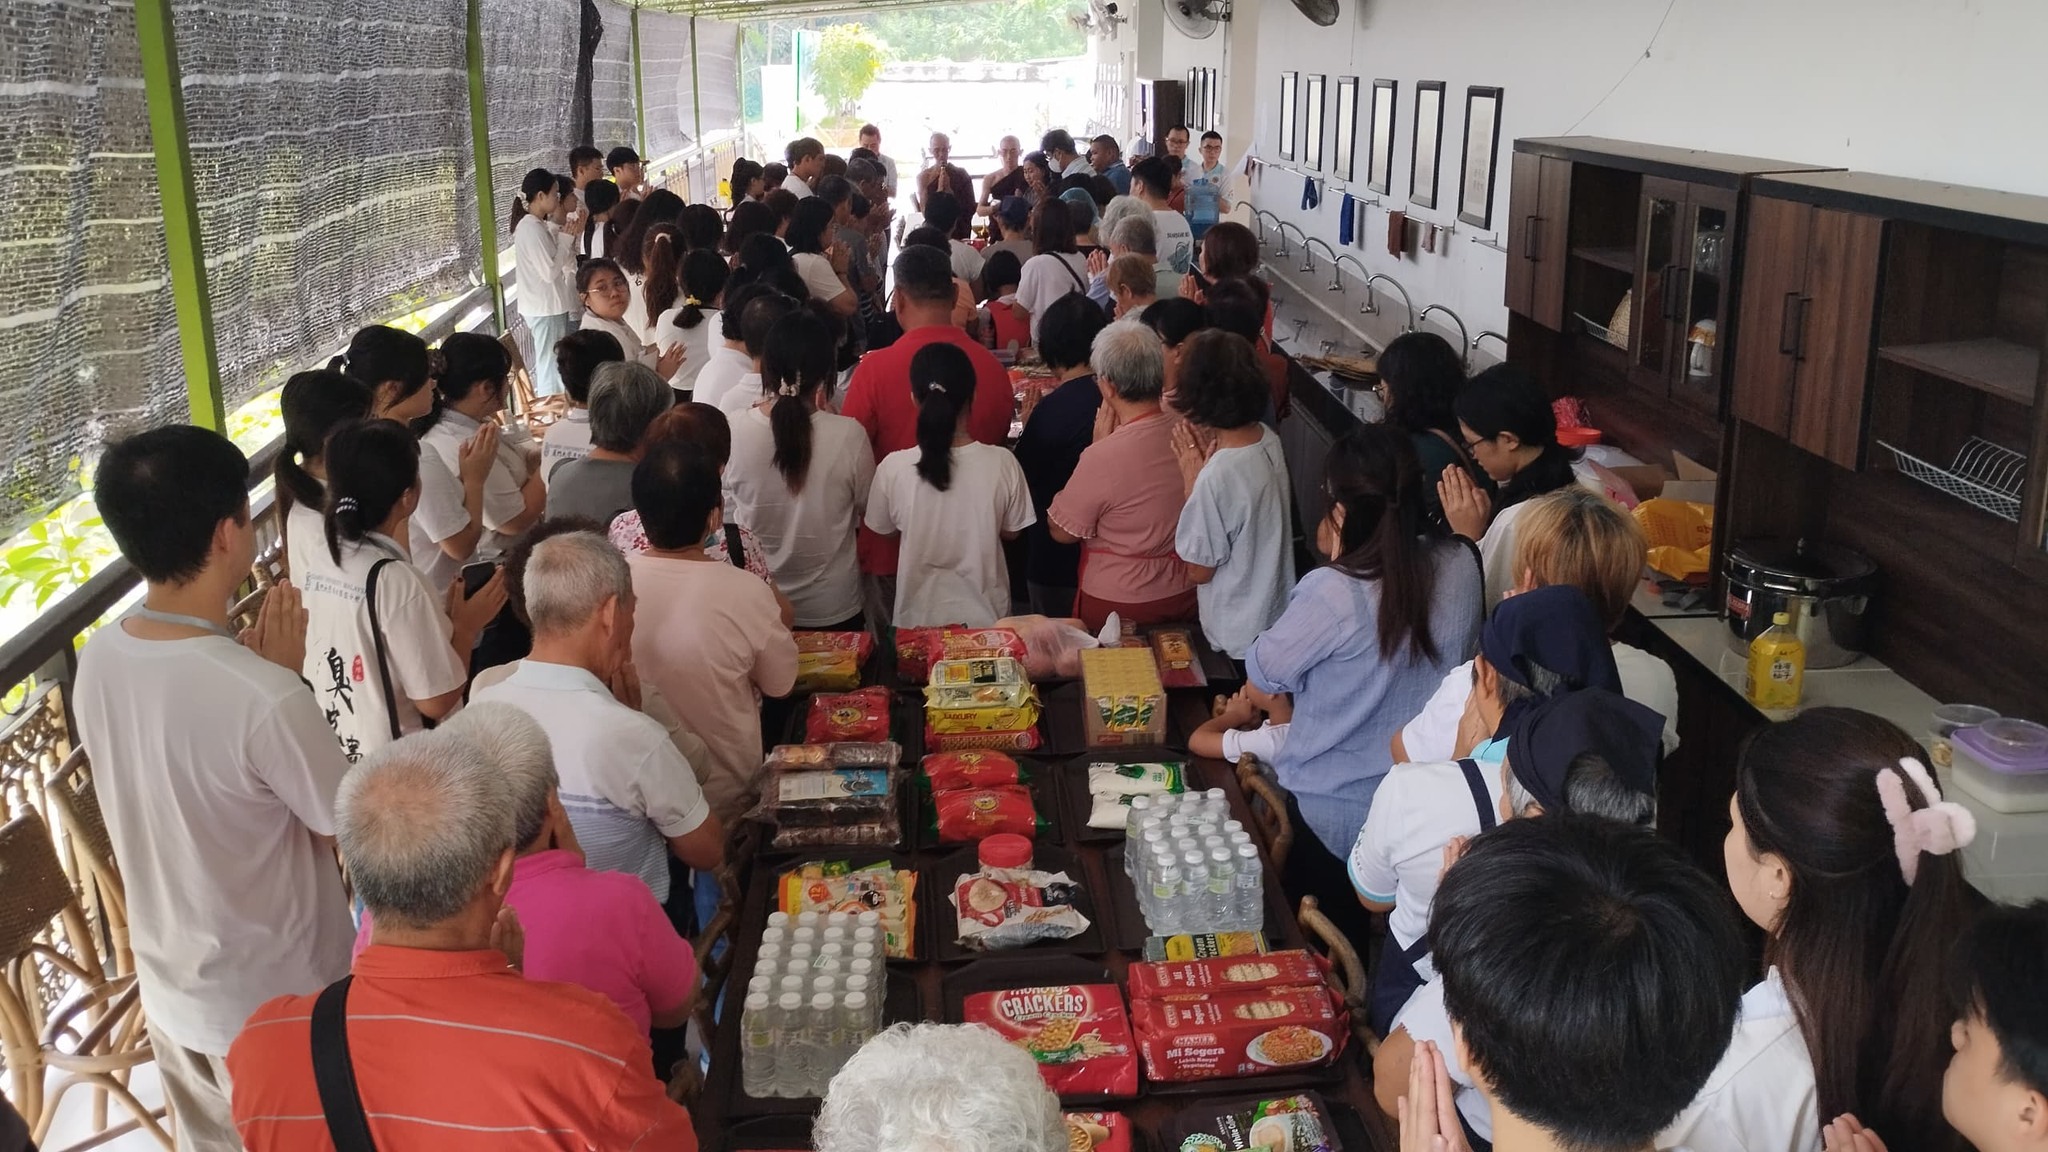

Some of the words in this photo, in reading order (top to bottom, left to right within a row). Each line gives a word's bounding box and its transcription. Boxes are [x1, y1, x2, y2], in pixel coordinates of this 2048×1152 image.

[1205, 933, 1218, 958] rackers
[1001, 994, 1084, 1017] CRACKERS
[1166, 1048, 1182, 1059] Mi
[1184, 1047, 1225, 1057] Segera
[1232, 1128, 1244, 1150] White
